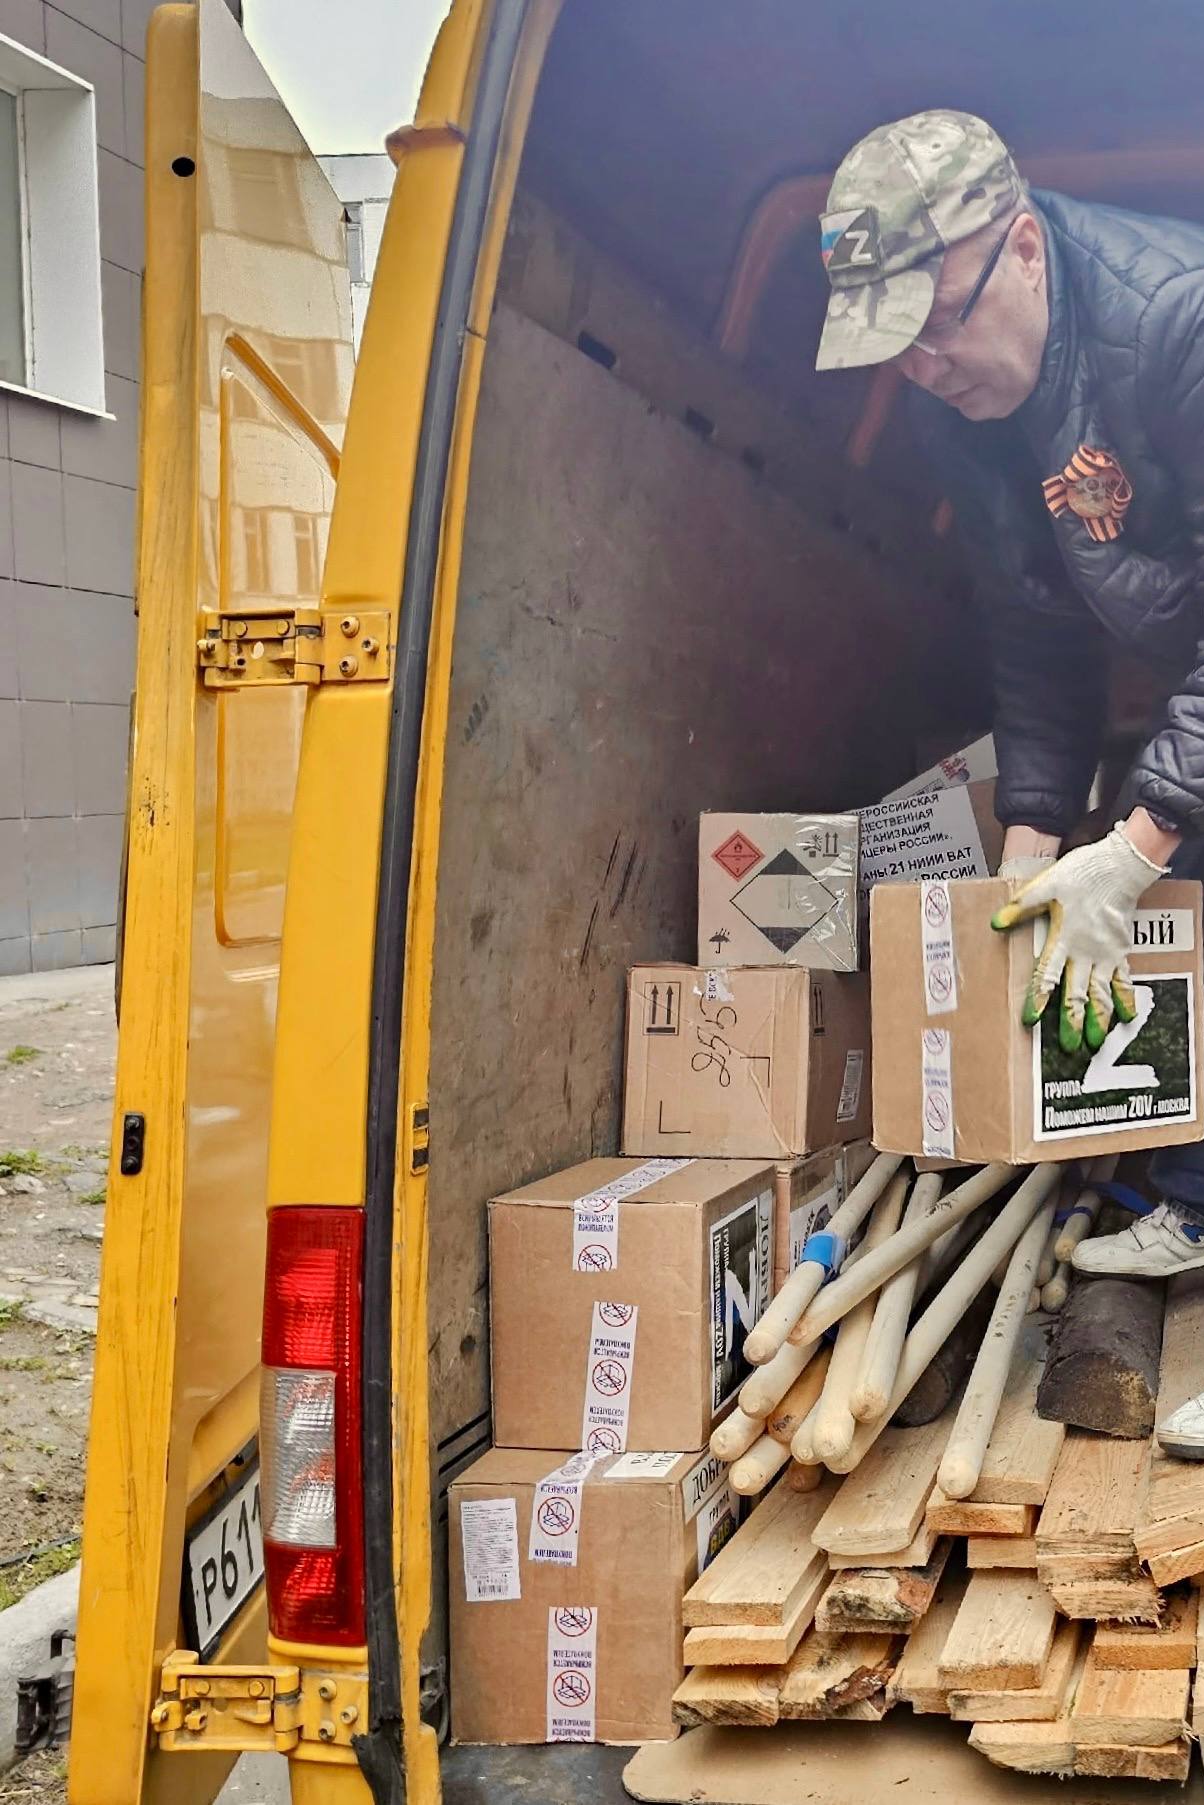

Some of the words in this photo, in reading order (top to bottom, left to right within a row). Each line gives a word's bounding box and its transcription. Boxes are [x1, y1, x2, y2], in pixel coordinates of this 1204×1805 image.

[845, 230, 872, 262] Z
[854, 793, 939, 819] ЕРОССИЙСКАЯ
[889, 860, 905, 875] 21
[946, 846, 972, 862] ВАТ
[1082, 984, 1160, 1093] Z
[1044, 1080, 1082, 1099] ГРУППА
[1128, 1095, 1153, 1118] ZOV
